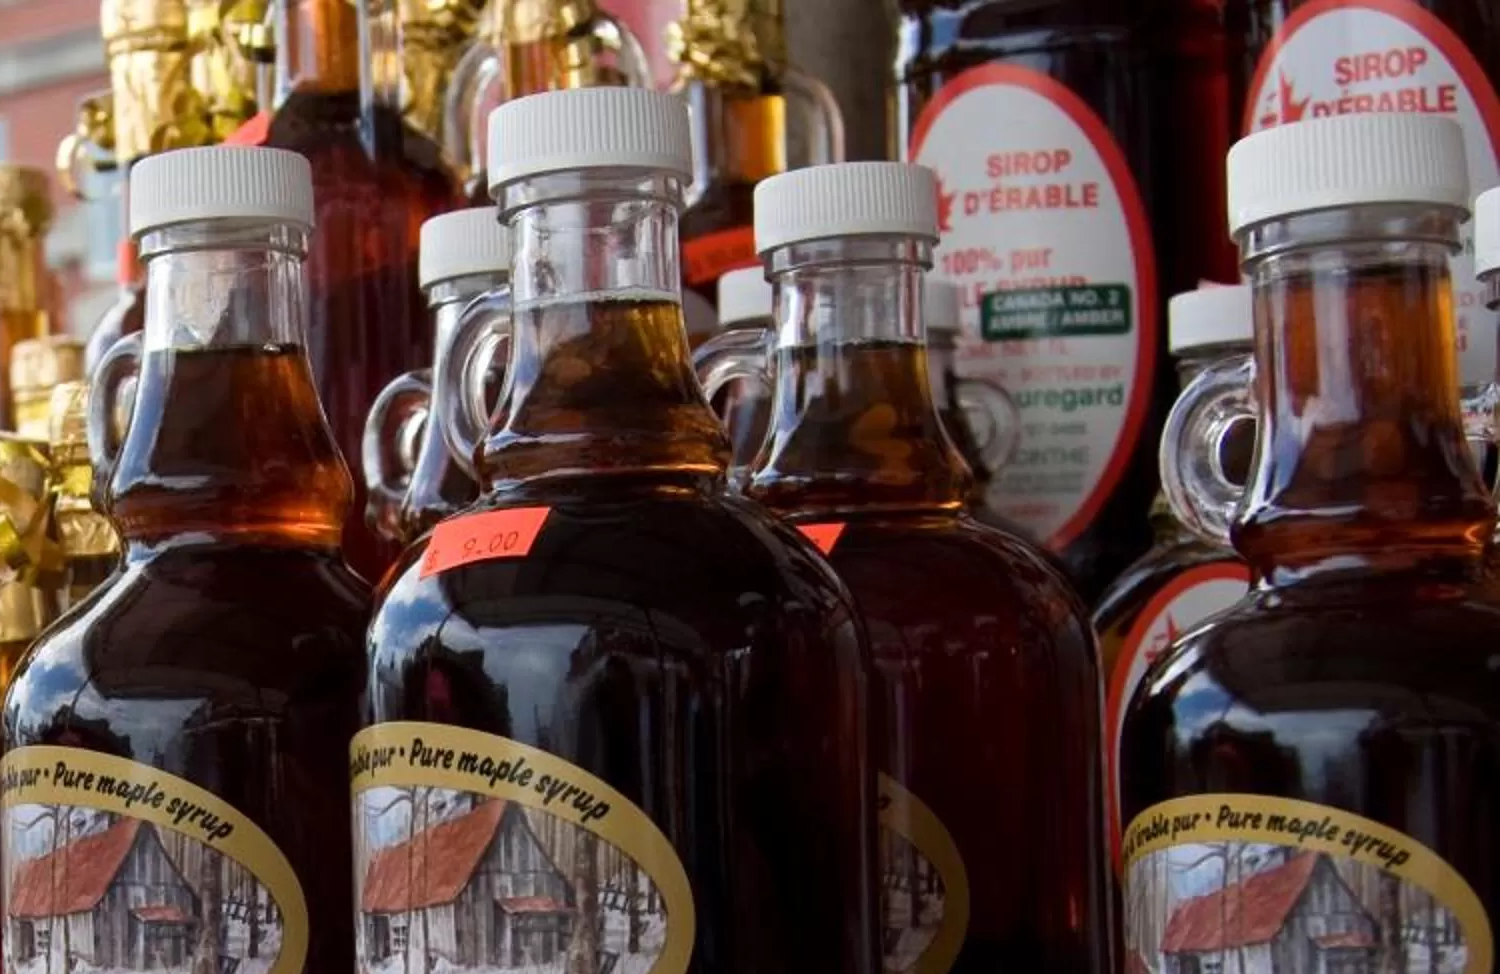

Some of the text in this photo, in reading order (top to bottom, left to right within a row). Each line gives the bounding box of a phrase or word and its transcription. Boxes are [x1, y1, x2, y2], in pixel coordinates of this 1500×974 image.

[1334, 46, 1428, 85] SIROP
[986, 150, 1073, 177] SIROP
[963, 181, 1099, 216] D'ÉRABLE
[1011, 248, 1053, 273] pur
[1015, 383, 1124, 411] uregard
[462, 531, 520, 559] 9.00
[408, 737, 454, 768] Pure
[457, 750, 534, 788] maple
[535, 774, 613, 823] syrup
[53, 760, 95, 788] Pure
[97, 774, 165, 808] maple
[166, 796, 235, 841] syrup
[1171, 811, 1202, 841] pur
[1216, 803, 1263, 830] Pure
[1266, 813, 1341, 843] maple
[1340, 826, 1411, 869] syrup
